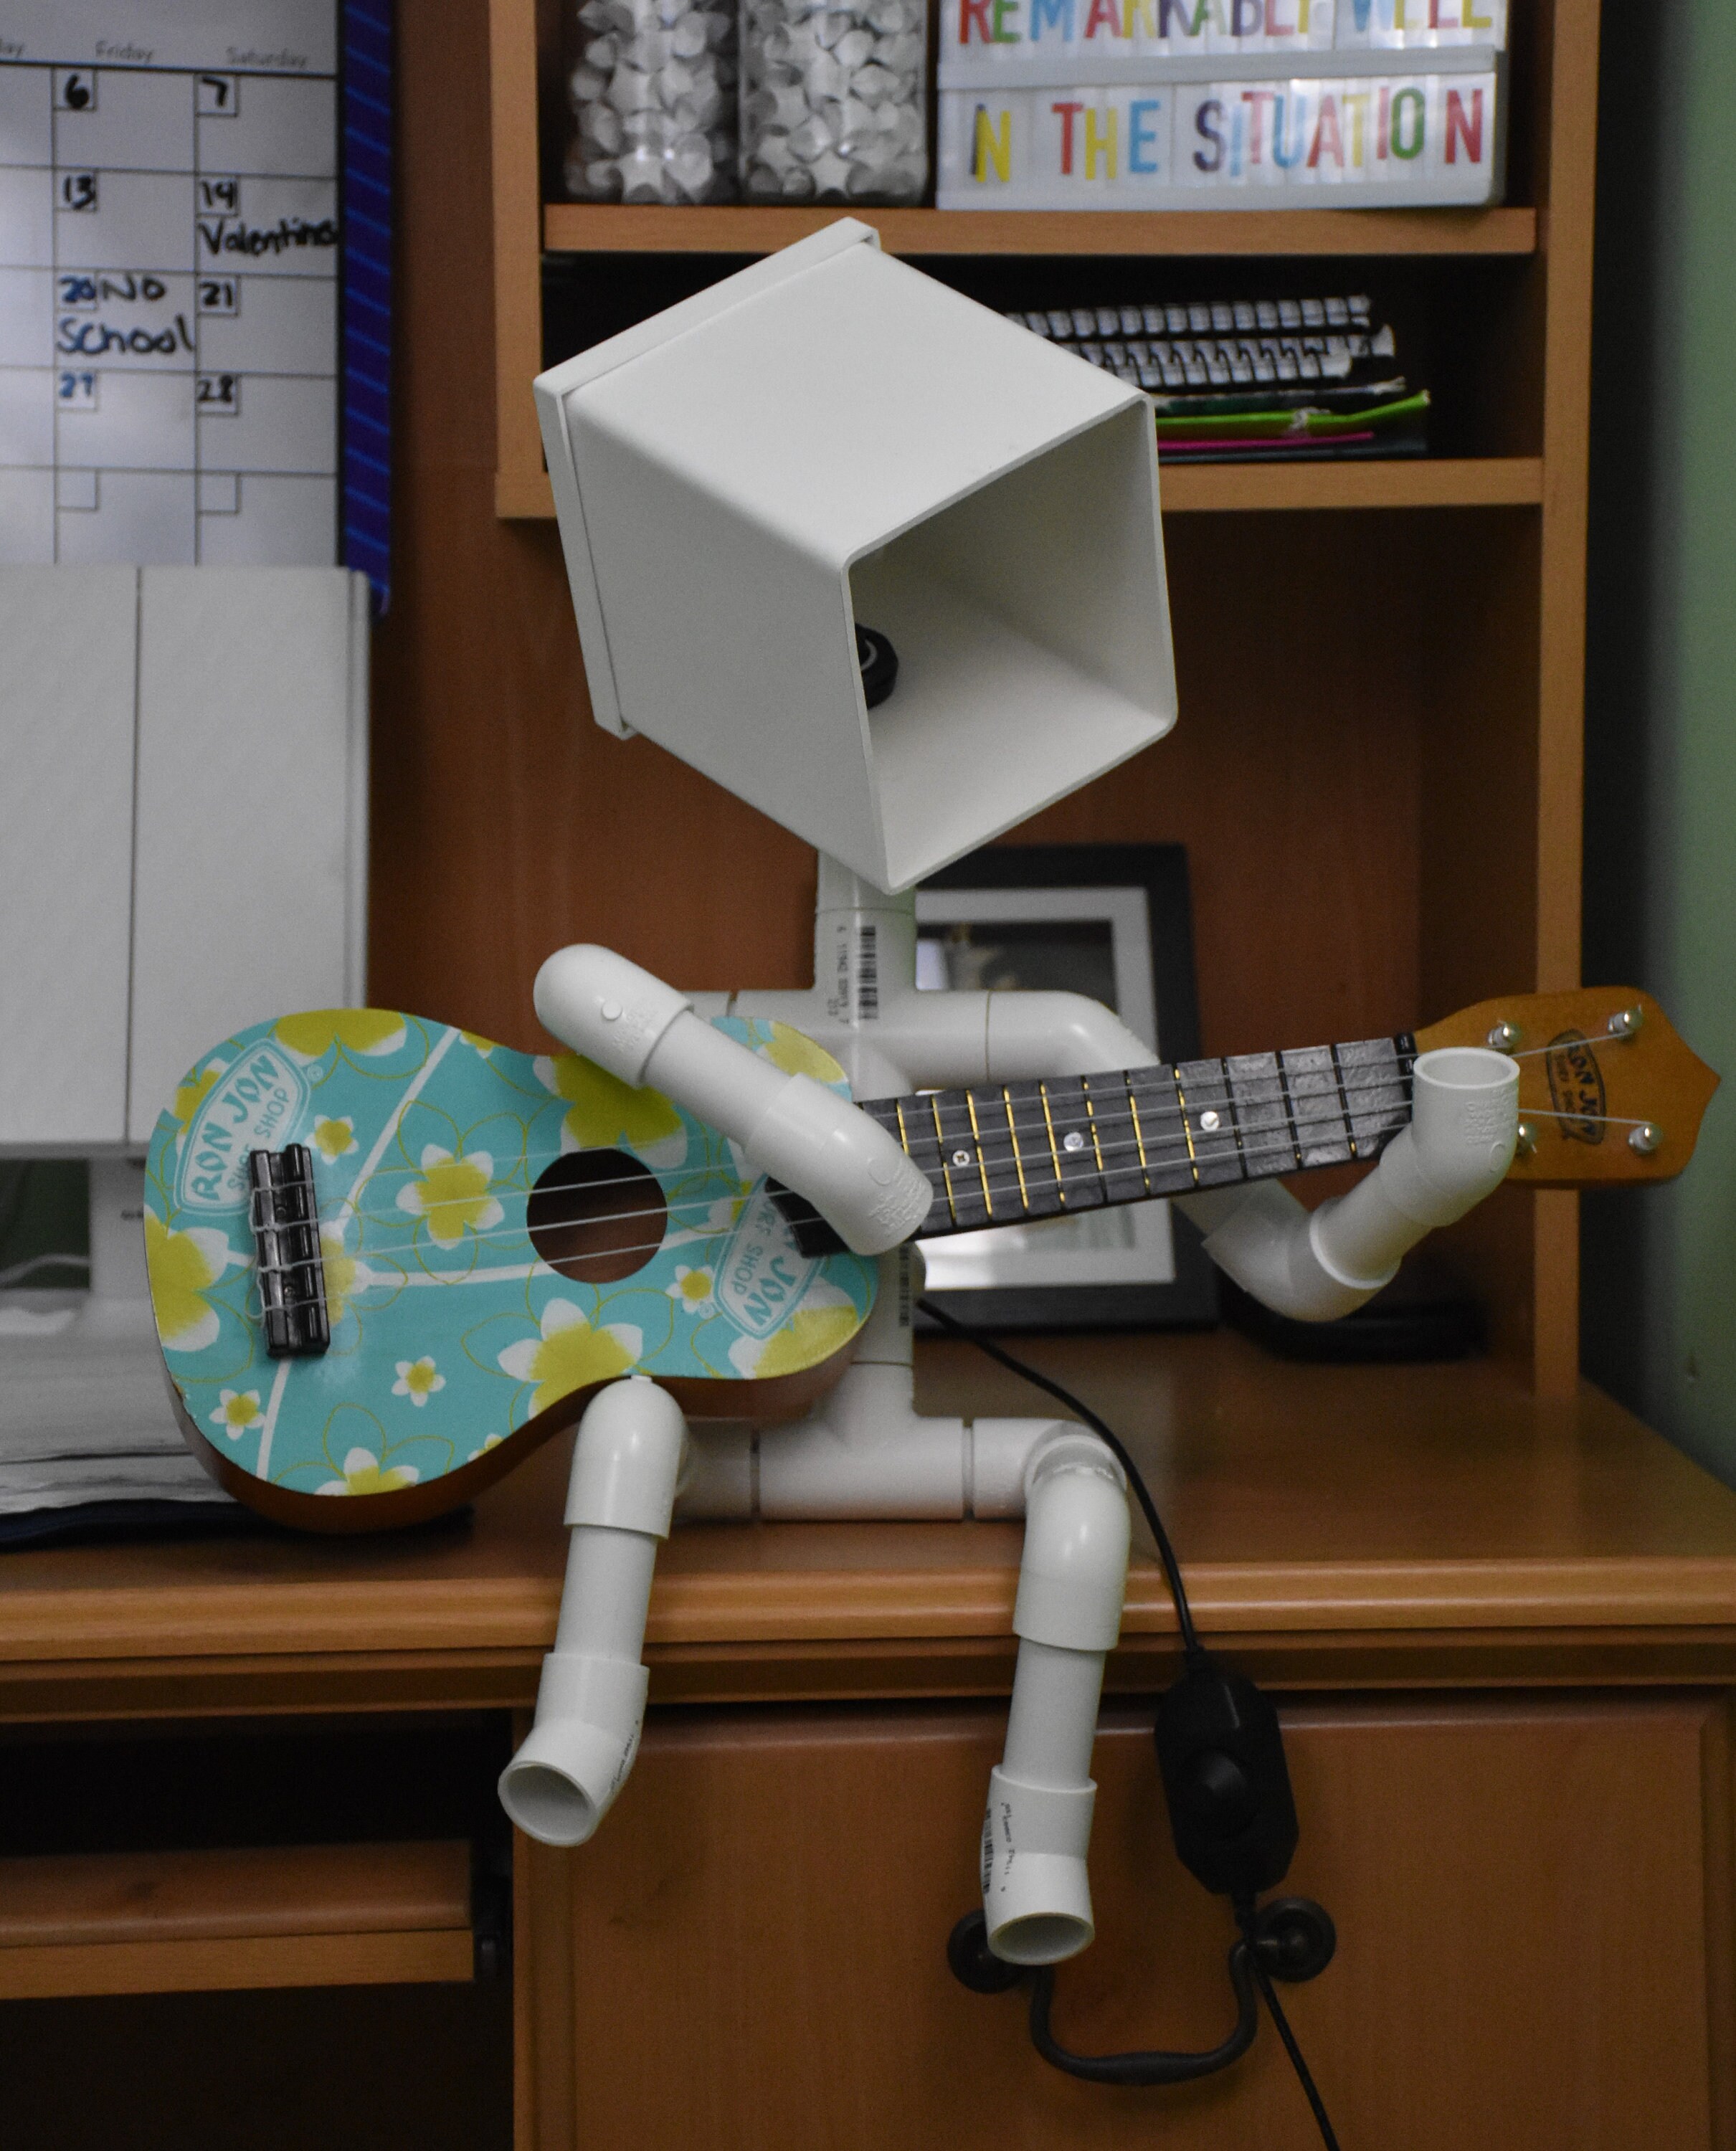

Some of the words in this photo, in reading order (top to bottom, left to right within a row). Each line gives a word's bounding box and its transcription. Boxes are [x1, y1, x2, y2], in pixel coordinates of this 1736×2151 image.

[65, 74, 90, 109] 6
[201, 75, 227, 107] 7
[1052, 100, 1160, 180] THE
[1193, 87, 1483, 176] SITUATION
[62, 174, 95, 210] 13
[201, 179, 236, 209] 14
[199, 280, 233, 307] 21
[59, 372, 94, 398] 27
[197, 375, 234, 403] 28
[191, 1121, 233, 1201] RON
[221, 1055, 280, 1124] JON
[253, 1087, 290, 1139] SHOP
[731, 1244, 764, 1295] SHOP
[743, 1255, 797, 1326] JON
